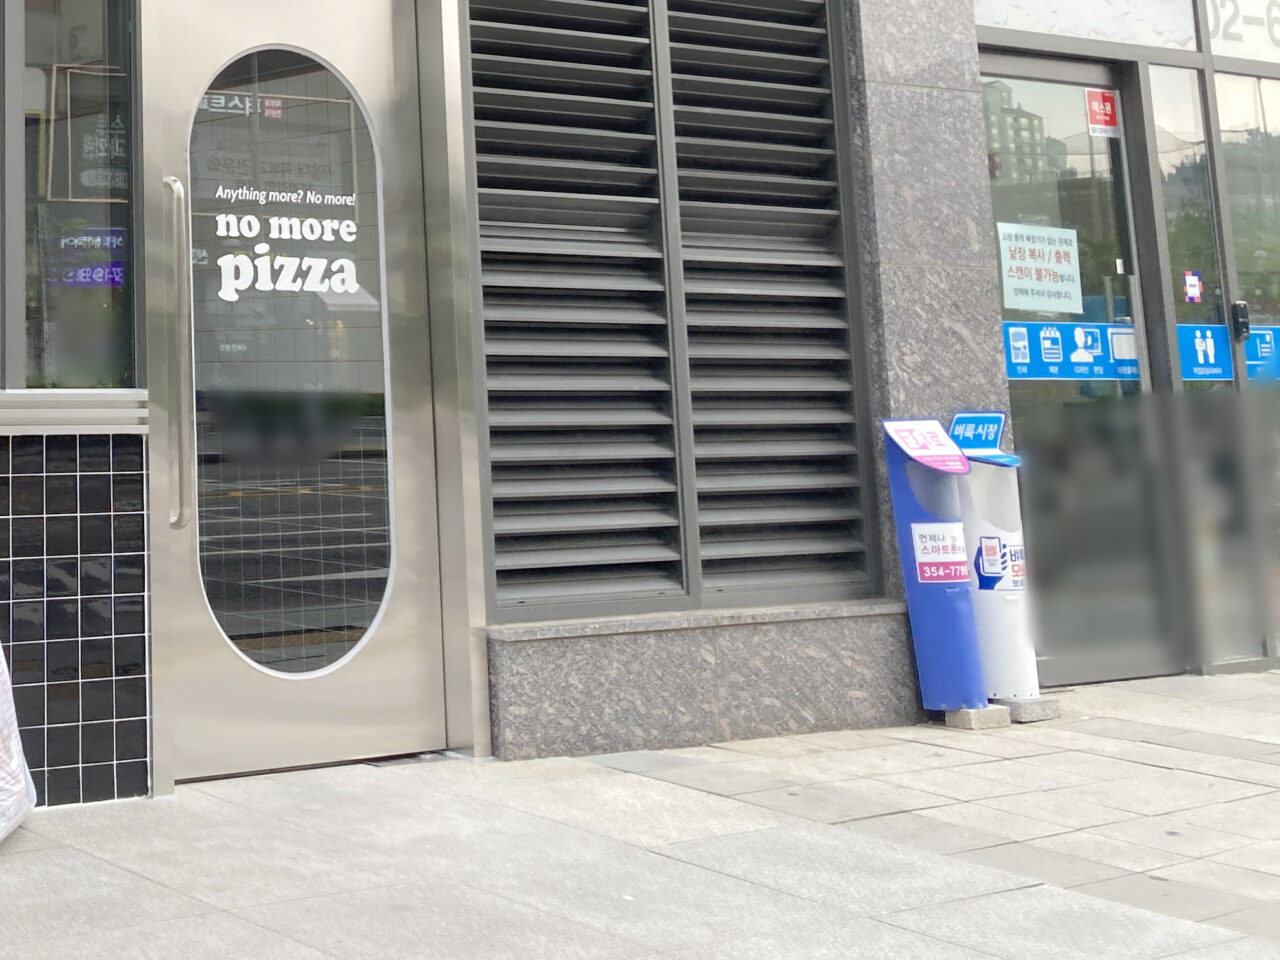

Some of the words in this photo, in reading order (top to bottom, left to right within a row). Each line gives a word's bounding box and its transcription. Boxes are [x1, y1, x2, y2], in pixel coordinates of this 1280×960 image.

[215, 185, 266, 205] Anything
[268, 189, 304, 203] more?
[306, 191, 322, 204] No
[324, 193, 356, 206] more!
[215, 213, 261, 238] no
[268, 215, 357, 242] more
[217, 243, 359, 302] pizza
[953, 423, 999, 440] 벼룩시장
[919, 533, 946, 544] 언제나
